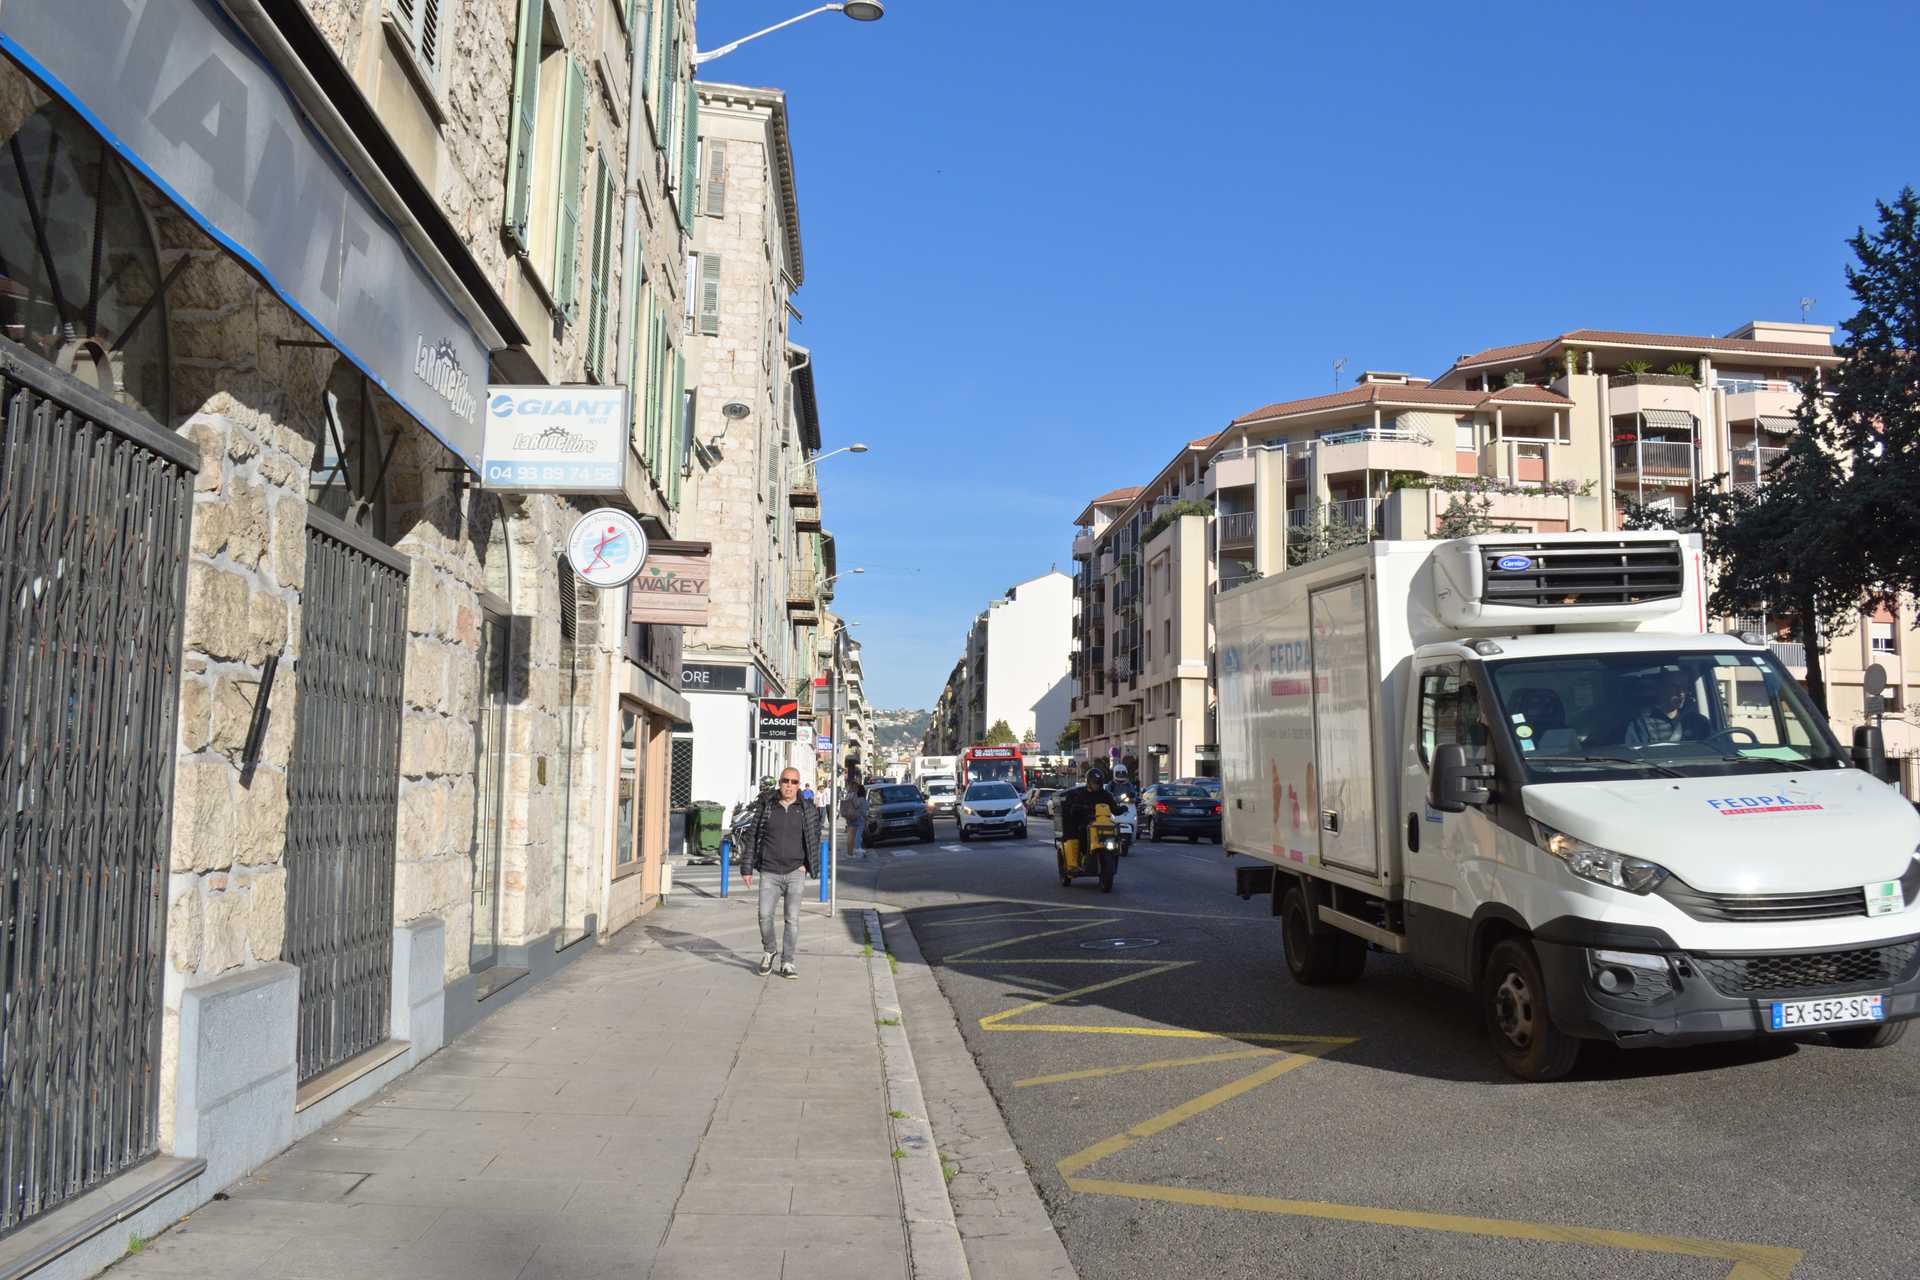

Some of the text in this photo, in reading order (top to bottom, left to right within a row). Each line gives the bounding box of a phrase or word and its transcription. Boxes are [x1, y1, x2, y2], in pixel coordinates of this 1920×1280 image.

[517, 399, 620, 416] GIANT
[490, 466, 512, 480] 04
[517, 466, 538, 480] 93
[543, 466, 565, 480] 89
[569, 466, 590, 481] 74
[637, 577, 705, 593] WAKEY
[1706, 795, 1795, 809] FEDPA
[1784, 998, 1870, 1025] EX-552-SC
